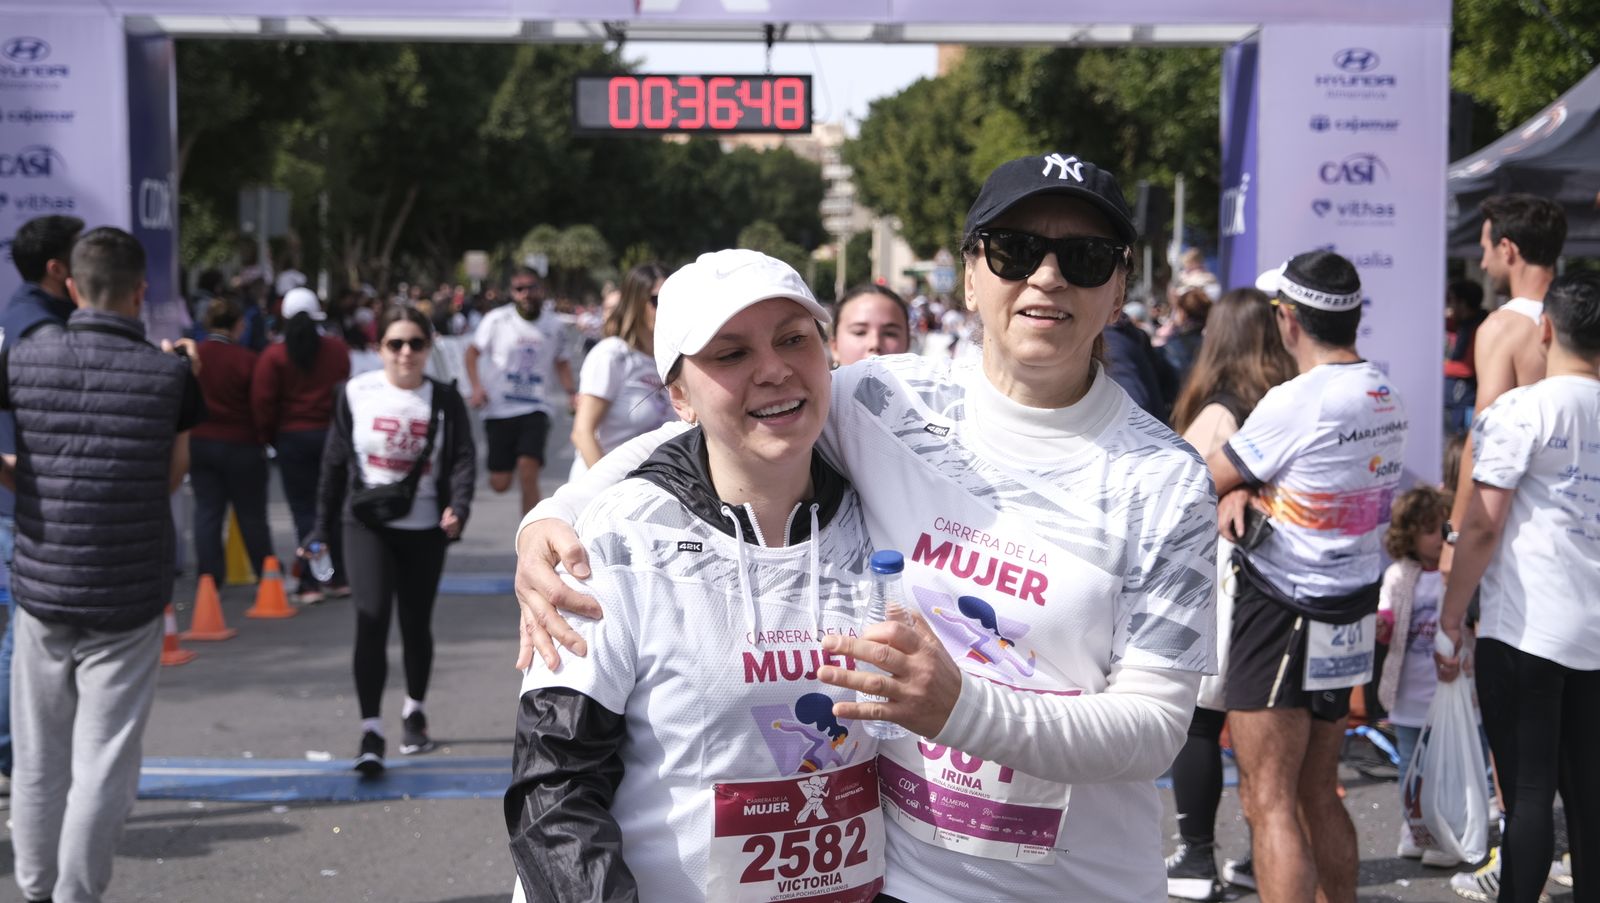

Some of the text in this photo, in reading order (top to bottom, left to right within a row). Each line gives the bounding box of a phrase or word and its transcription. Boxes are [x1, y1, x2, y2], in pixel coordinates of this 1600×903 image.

[608, 76, 805, 130] 00:36:48
[1319, 158, 1376, 185] CASI
[1336, 202, 1395, 217] vithas
[1351, 253, 1393, 268] ualia
[679, 542, 701, 551] 42K
[934, 517, 1048, 566] CARRERA DE LA
[911, 532, 1049, 606] MUJER
[746, 629, 812, 645] CARRERA
[898, 777, 919, 795] CDX
[941, 767, 982, 791] IRINA
[746, 796, 771, 804] CARRERA
[941, 796, 970, 809] ALMERÍA
[743, 802, 790, 816] MUJER
[739, 817, 868, 884] 2582
[777, 872, 843, 893] VICTORIA
[770, 892, 796, 901] VICTORIA
